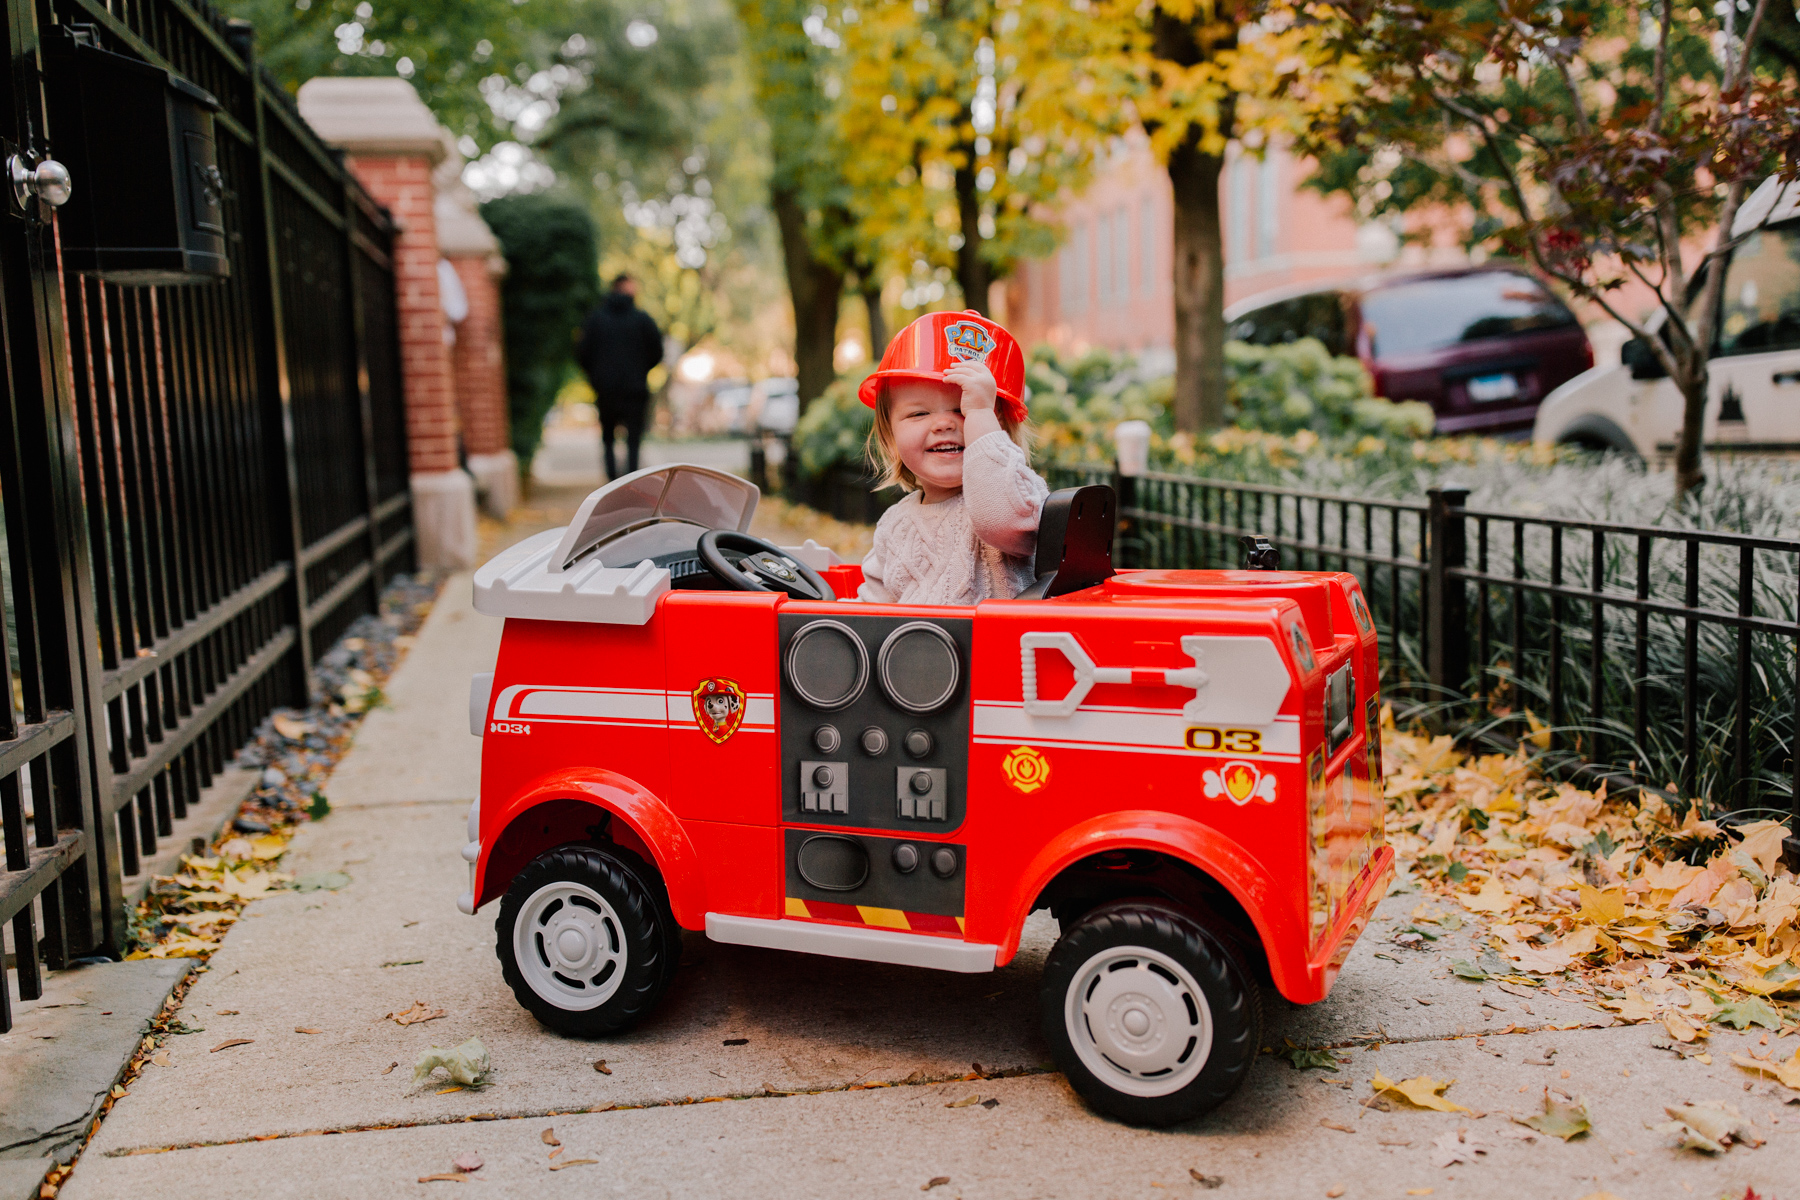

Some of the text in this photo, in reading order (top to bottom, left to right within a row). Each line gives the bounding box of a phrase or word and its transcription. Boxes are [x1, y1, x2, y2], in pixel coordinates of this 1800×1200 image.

[945, 326, 996, 354] PAW
[954, 347, 981, 360] PATROL
[497, 723, 524, 734] 03
[1185, 726, 1263, 754] 03
